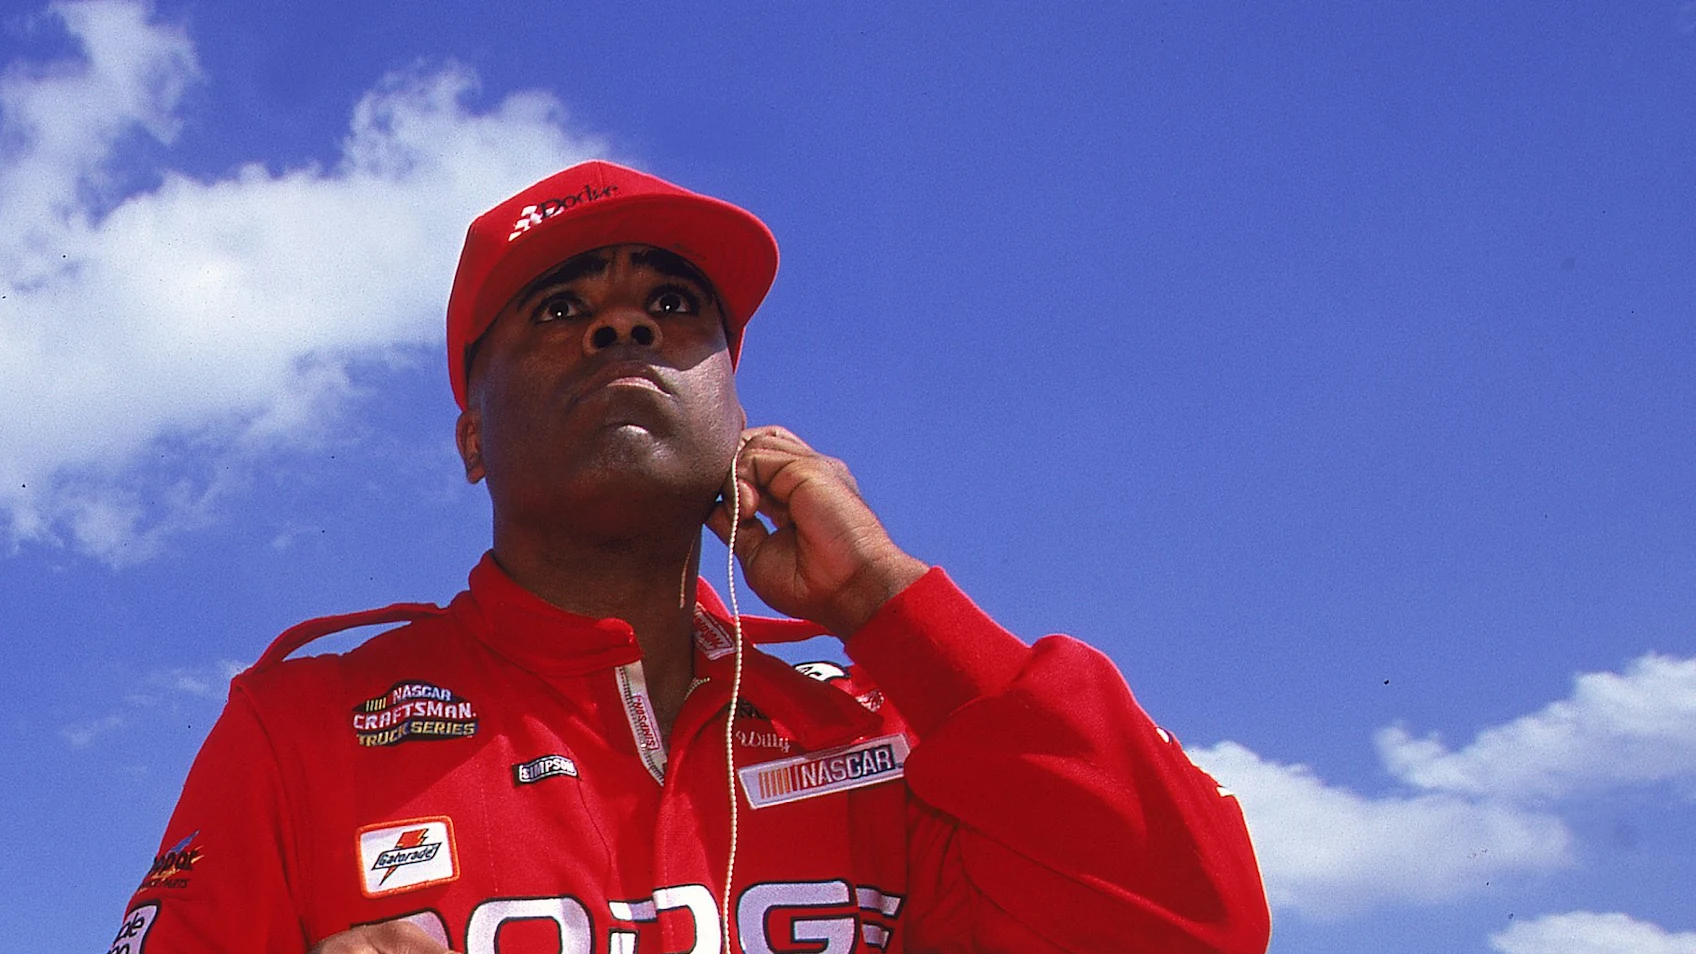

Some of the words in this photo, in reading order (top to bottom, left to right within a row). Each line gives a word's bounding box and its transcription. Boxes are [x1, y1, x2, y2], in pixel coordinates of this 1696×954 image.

[392, 684, 452, 704] NASCAR
[353, 701, 473, 730] CRAFTSMAN
[356, 721, 409, 747] TRUCK
[410, 721, 475, 736] SERIES
[735, 730, 791, 753] Willy
[521, 758, 575, 780] SIMPSON
[800, 747, 893, 788] NASCAR
[378, 847, 435, 867] Gatorade
